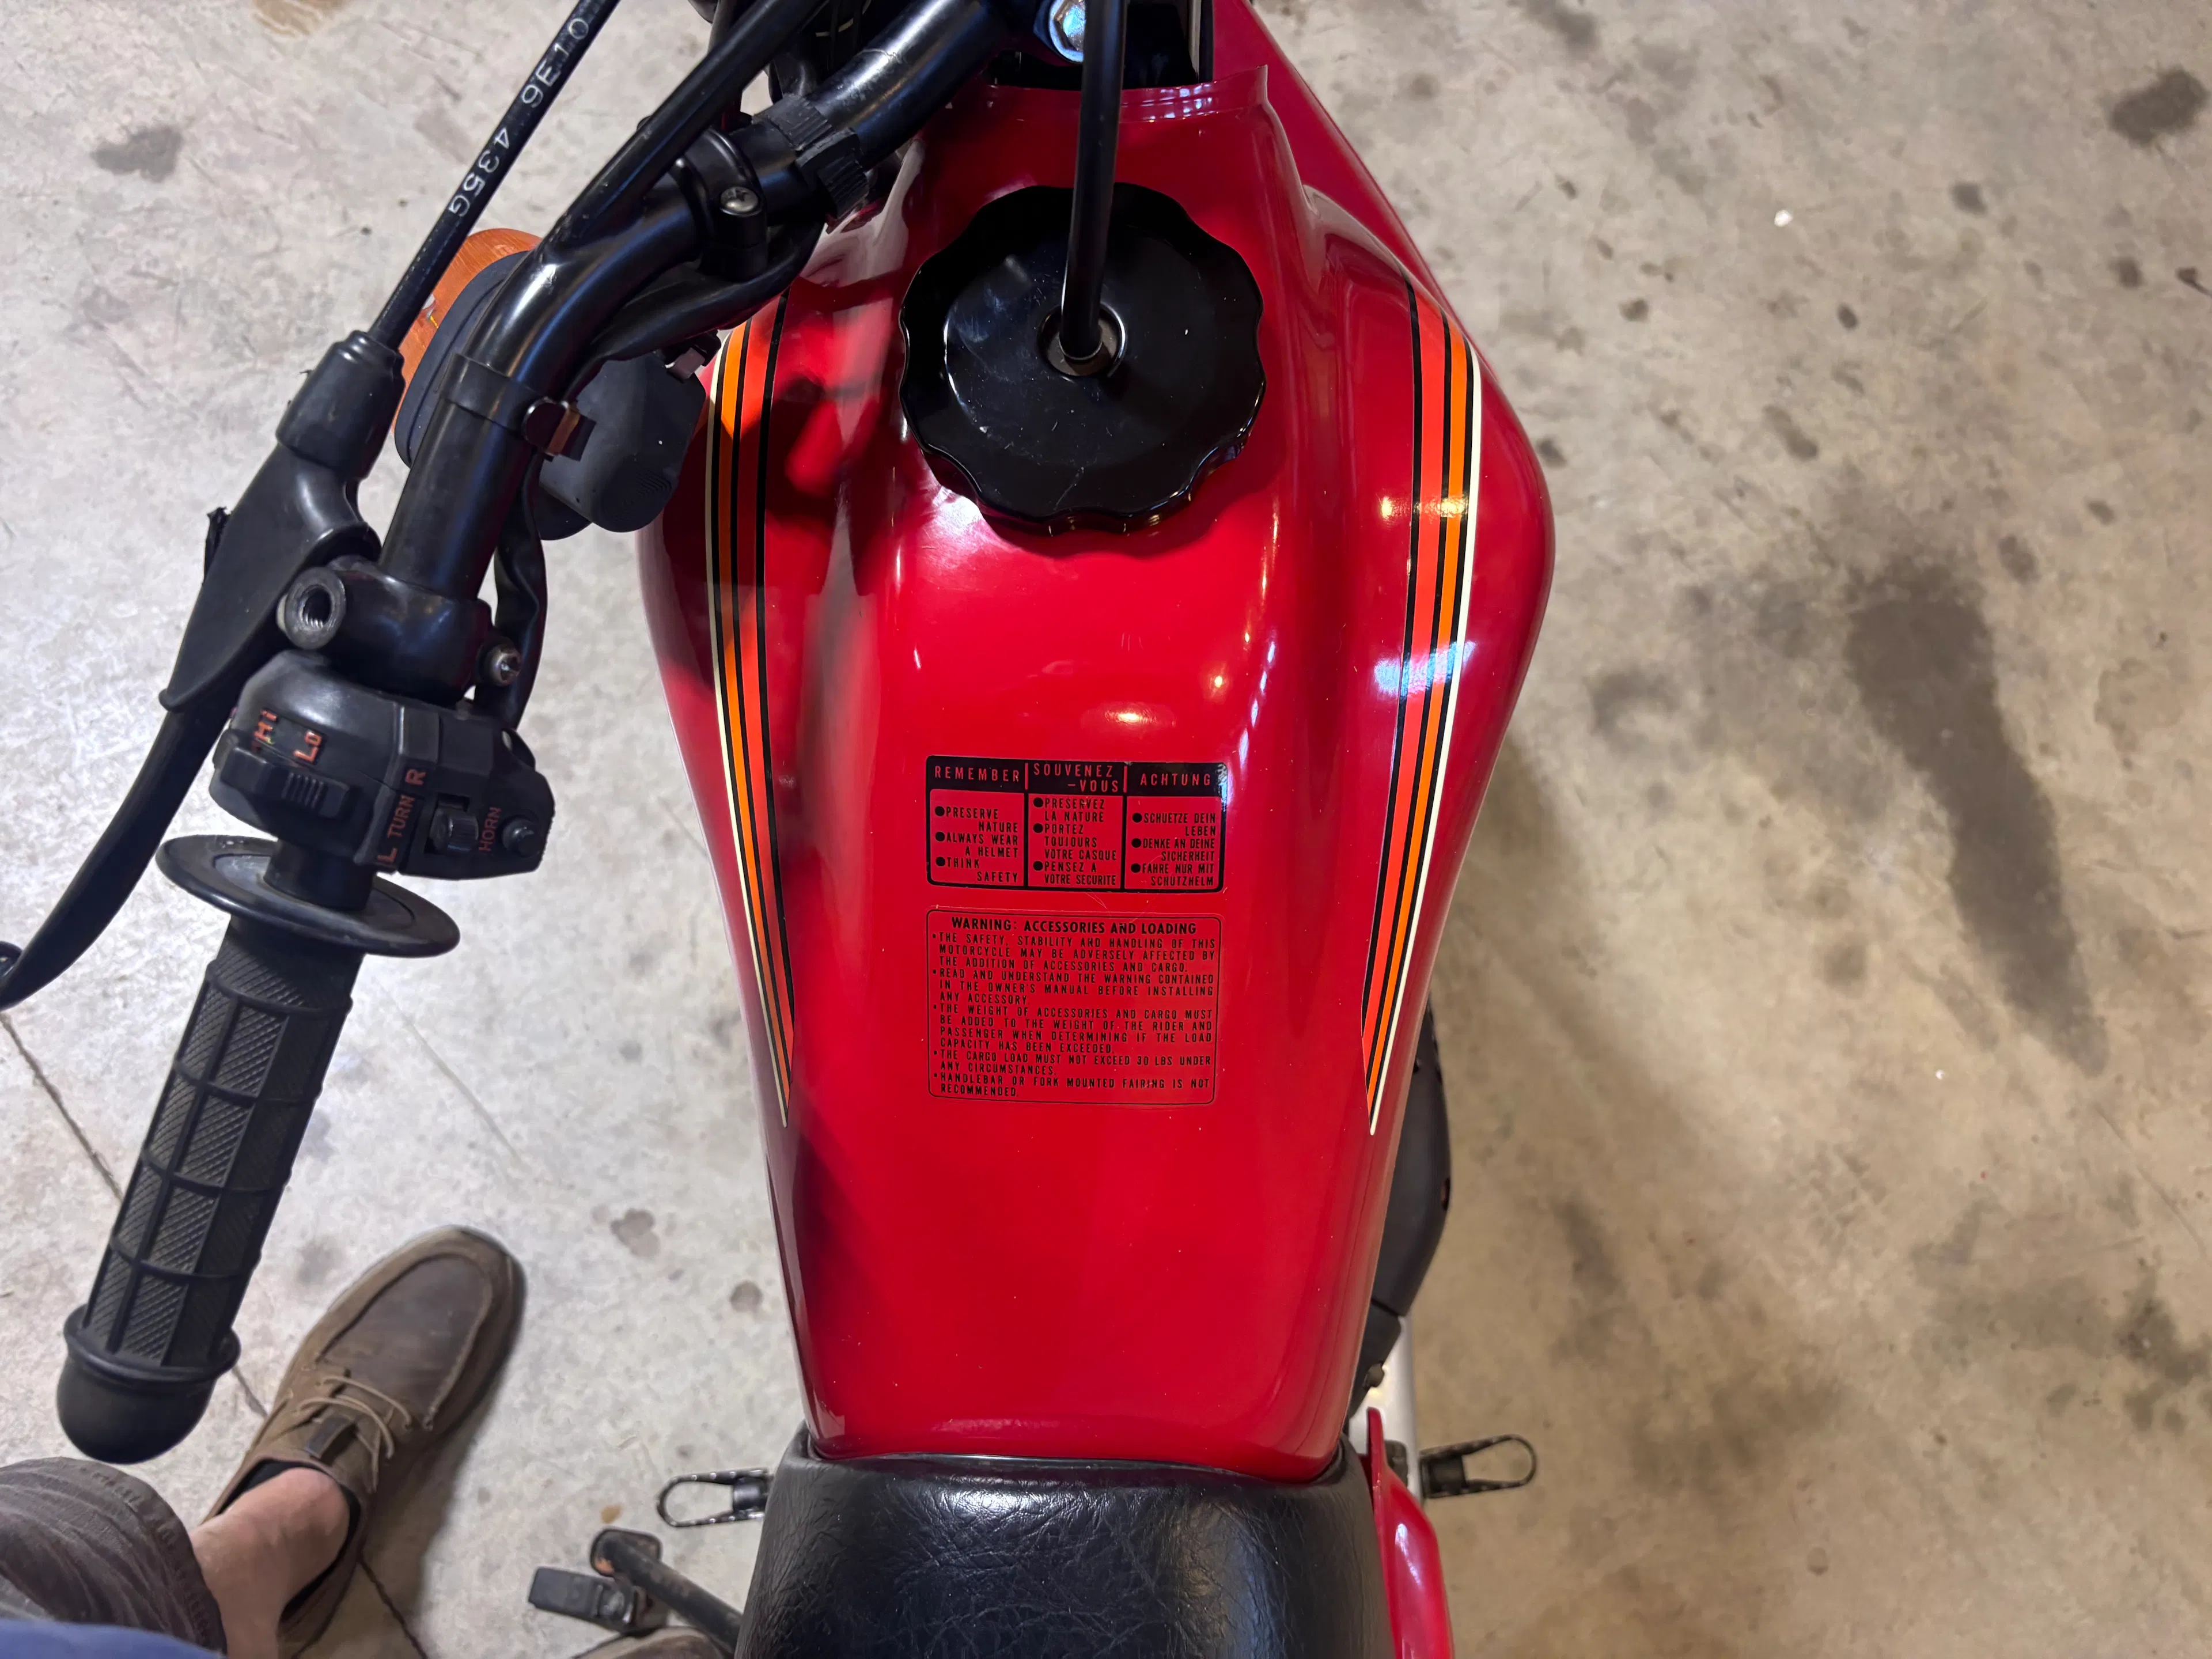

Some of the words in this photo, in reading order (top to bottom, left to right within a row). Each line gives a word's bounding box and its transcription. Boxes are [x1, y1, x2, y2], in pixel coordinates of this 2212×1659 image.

[449, 128, 509, 216] 435G
[254, 710, 276, 744] Hi
[293, 730, 322, 762] Lo
[935, 766, 1019, 782] REMEMBER
[1033, 763, 1112, 777] SOUVENEZ
[1140, 773, 1211, 786] ACHTUNG
[1045, 798, 1104, 809] PRESERVEZ
[377, 848, 397, 862] L
[388, 794, 415, 838] TURN
[405, 768, 426, 786] R
[946, 806, 998, 819] PRESERVE
[1045, 811, 1056, 821] LA
[1065, 812, 1103, 822] NATURE
[1144, 813, 1188, 823] SCHUETZE
[1194, 813, 1215, 823] DEIN
[479, 807, 502, 852] HORN
[979, 821, 1017, 832] NATURE
[1045, 824, 1083, 834] PORTEZ
[1185, 826, 1215, 836] LEBEN
[947, 832, 983, 844] ALWAYS
[992, 835, 1017, 845] WEAR
[1045, 836, 1097, 847] TOUJOURS
[1143, 838, 1170, 849] DENKE
[1175, 839, 1185, 849] AN
[1190, 839, 1214, 849] DEINE
[965, 846, 970, 855] A
[978, 847, 1018, 858] HELMET
[1045, 849, 1073, 859] VOTRE
[1080, 850, 1116, 860] CASQUE
[1161, 851, 1214, 861] SICHERHEIT
[947, 857, 979, 868] THINK
[1045, 861, 1084, 872] PENSEZ
[1092, 863, 1096, 872] A
[1143, 863, 1168, 873] FAHRE
[1176, 864, 1192, 873] NUR
[1198, 863, 1213, 873] MIT
[978, 872, 1017, 882] SAFETY
[1045, 874, 1070, 884] VOTRE
[1076, 874, 1116, 885] SECURITE
[1151, 876, 1213, 886] SCHUTZHELM
[952, 917, 1016, 930] WARNING:
[1024, 921, 1104, 933] ACCESSORIES
[1111, 923, 1135, 934] AND
[1142, 923, 1196, 934] LOADING
[940, 932, 956, 942] THE
[1018, 936, 1071, 946] STABILITY
[1081, 938, 1100, 947] AND
[1110, 938, 1162, 948] HANDLING
[1172, 939, 1183, 948] OF
[1192, 939, 1214, 948] THIS
[940, 944, 1010, 957] MOTORCYCLE
[1021, 948, 1041, 958] MAY
[1052, 949, 1063, 958] BE
[1074, 949, 1134, 960] ADVERSELY
[1143, 950, 1194, 960] AFFECTED
[1203, 950, 1214, 960] BY
[940, 956, 956, 966] THE
[966, 957, 1014, 968] ADDITION
[1024, 960, 1034, 969] OF
[1044, 960, 1114, 971] ACCESSORIES
[1123, 963, 1142, 972] AND
[1152, 963, 1187, 972] CARGO.
[940, 968, 964, 978] READ
[974, 970, 993, 979] AND
[1002, 971, 1069, 982] UNDERSTAND
[1078, 974, 1095, 983] THE
[1105, 974, 1150, 983] WARNING
[1159, 975, 1213, 984] CONTAINED
[940, 980, 950, 989] IN
[960, 981, 978, 991] THE
[988, 982, 1035, 993] OWNER'S
[1045, 984, 1088, 994] MANUAL
[1099, 986, 1138, 995] BEFORE
[1149, 987, 1213, 995] INSTALLING
[940, 991, 959, 1001] ANY
[941, 1003, 957, 1013] THE
[968, 1005, 1007, 1015] WEIGHT
[1018, 1007, 1028, 1016] OF
[1037, 1007, 1107, 1018] ACCESSORIES
[1116, 1009, 1135, 1018] AND
[1145, 1010, 1176, 1020] CARGO
[1185, 1010, 1211, 1019] MUST
[941, 1014, 951, 1024] BE
[961, 1016, 993, 1027] ADDED
[1005, 1018, 1016, 1027] TO
[1025, 1019, 1043, 1028] THE
[1054, 1020, 1093, 1029] WEIGHT
[1104, 1021, 1114, 1030] OF
[1125, 1021, 1142, 1031] THE
[1153, 1021, 1183, 1031] RIDER
[1192, 1021, 1211, 1031] AND
[941, 1026, 1002, 1039] PASSENGER
[1013, 1031, 1041, 1040] WHEN
[1052, 1032, 1127, 1042] DETERMINING
[1137, 1033, 1146, 1042] IF
[1157, 1033, 1175, 1043] THE
[1185, 1033, 1211, 1042] LOAD
[941, 1037, 989, 1049] CAPACITY
[999, 1041, 1017, 1051] HAS
[1027, 1042, 1051, 1051] BEEN
[1060, 1043, 1114, 1053] EXCEEDED.
[941, 1049, 957, 1059] THE
[967, 1051, 996, 1062] CARGO
[1005, 1053, 1028, 1062] LOAD
[1036, 1054, 1060, 1063] MUST
[1069, 1055, 1086, 1064] NOT
[1094, 1055, 1130, 1065] EXCEED
[1137, 1056, 1149, 1065] 30
[1156, 1056, 1172, 1066] LBS
[1180, 1056, 1210, 1065] UNDER
[941, 1061, 959, 1070] ANY
[968, 1063, 1056, 1075] CIRCUMSTANCES.
[941, 1072, 1002, 1084] HANDLEBAR
[1013, 1076, 1024, 1085] OR
[1034, 1077, 1058, 1086] FORK
[1067, 1078, 1114, 1088] MOUNTED
[1123, 1079, 1164, 1088] FAIRING
[1173, 1080, 1182, 1088] IS
[1191, 1079, 1209, 1088] NOT
